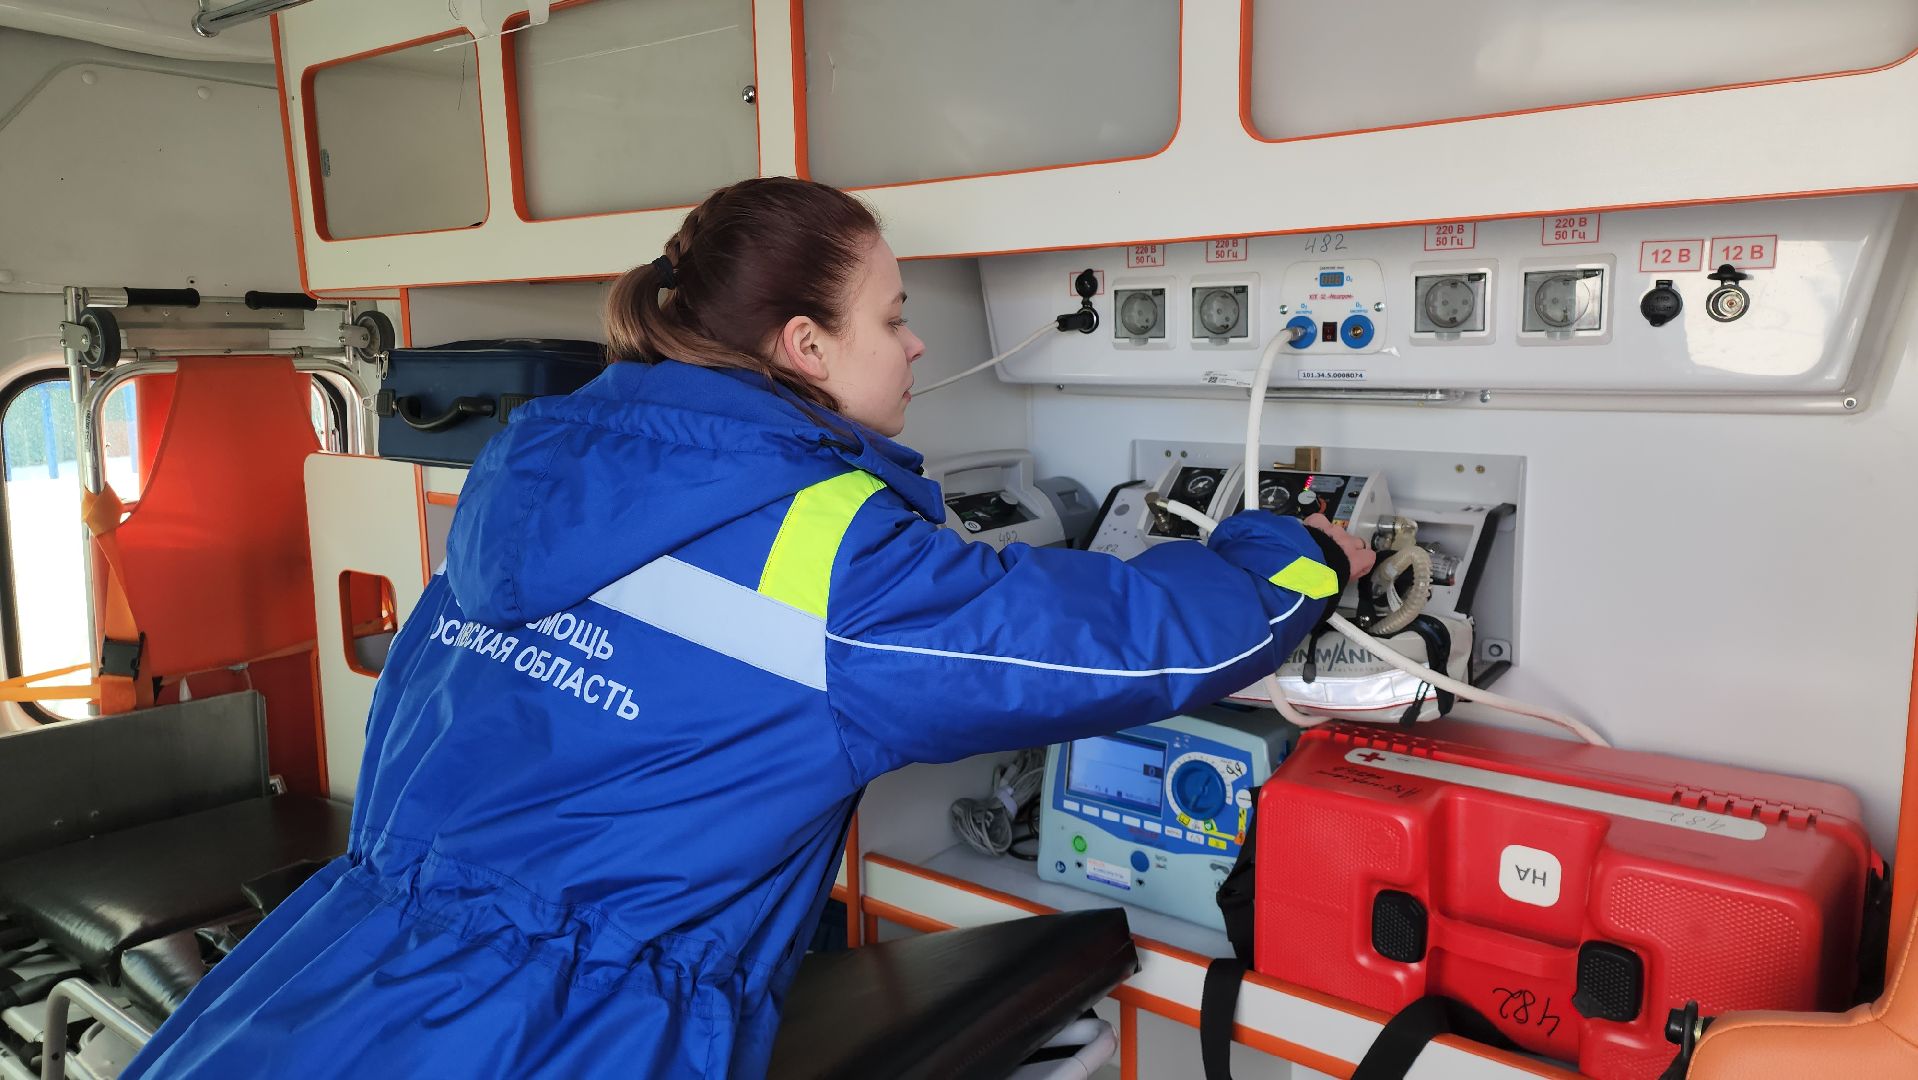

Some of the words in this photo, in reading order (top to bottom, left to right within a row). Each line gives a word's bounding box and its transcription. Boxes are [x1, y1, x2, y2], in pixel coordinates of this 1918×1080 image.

[1555, 218, 1575, 228] 220
[1579, 217, 1588, 227] В
[1436, 225, 1453, 235] 220
[1457, 224, 1465, 234] В
[1555, 230, 1568, 240] 50
[1571, 229, 1586, 240] Гц
[1215, 239, 1229, 249] 220
[1304, 233, 1348, 253] 482
[1436, 236, 1447, 246] 50
[1450, 236, 1464, 246] Гц
[1135, 246, 1149, 255] 220
[1215, 250, 1225, 259] 50
[1227, 250, 1238, 259] Гц
[1651, 248, 1672, 264] 12
[1678, 248, 1691, 263] В
[1722, 245, 1744, 261] 12
[1750, 244, 1764, 260] В
[1135, 255, 1145, 265] 50
[1146, 255, 1156, 265] Гц
[515, 646, 640, 721] ОБЛАСТЬ
[1492, 987, 1561, 1036] 482
